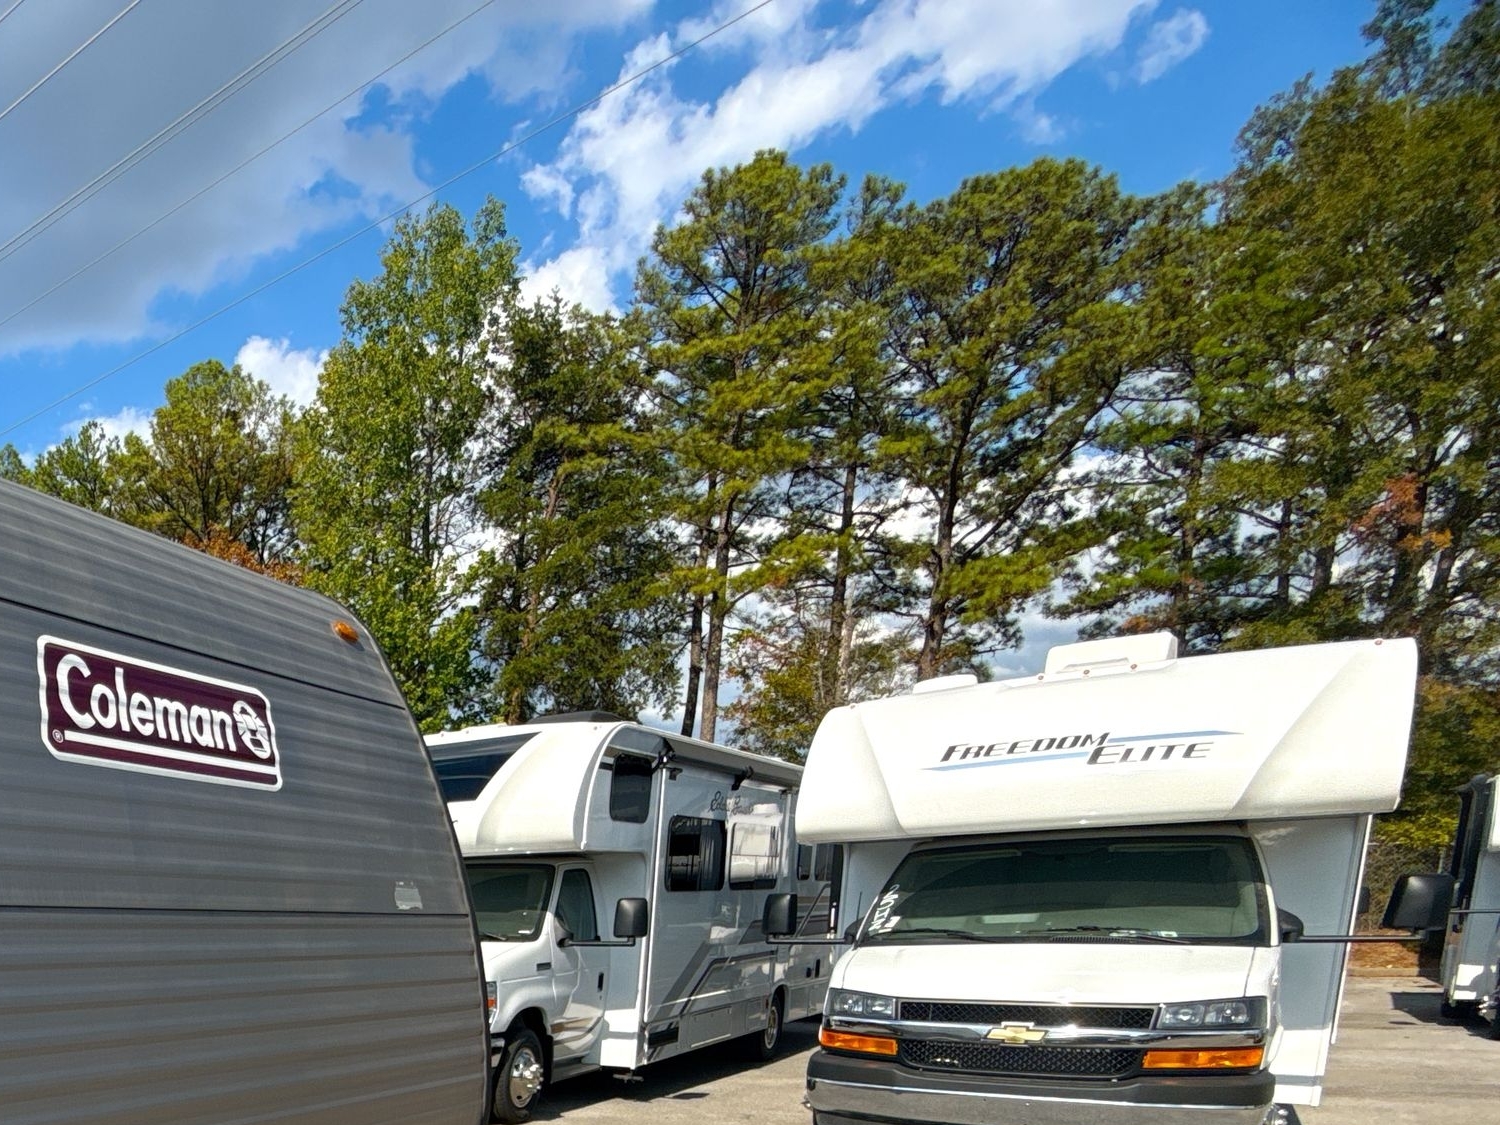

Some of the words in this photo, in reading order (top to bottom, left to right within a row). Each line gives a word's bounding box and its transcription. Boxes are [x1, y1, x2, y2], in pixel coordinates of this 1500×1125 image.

[56, 653, 236, 752] Coleman
[940, 732, 1110, 762] FREEDOM
[1086, 742, 1214, 765] ELITE
